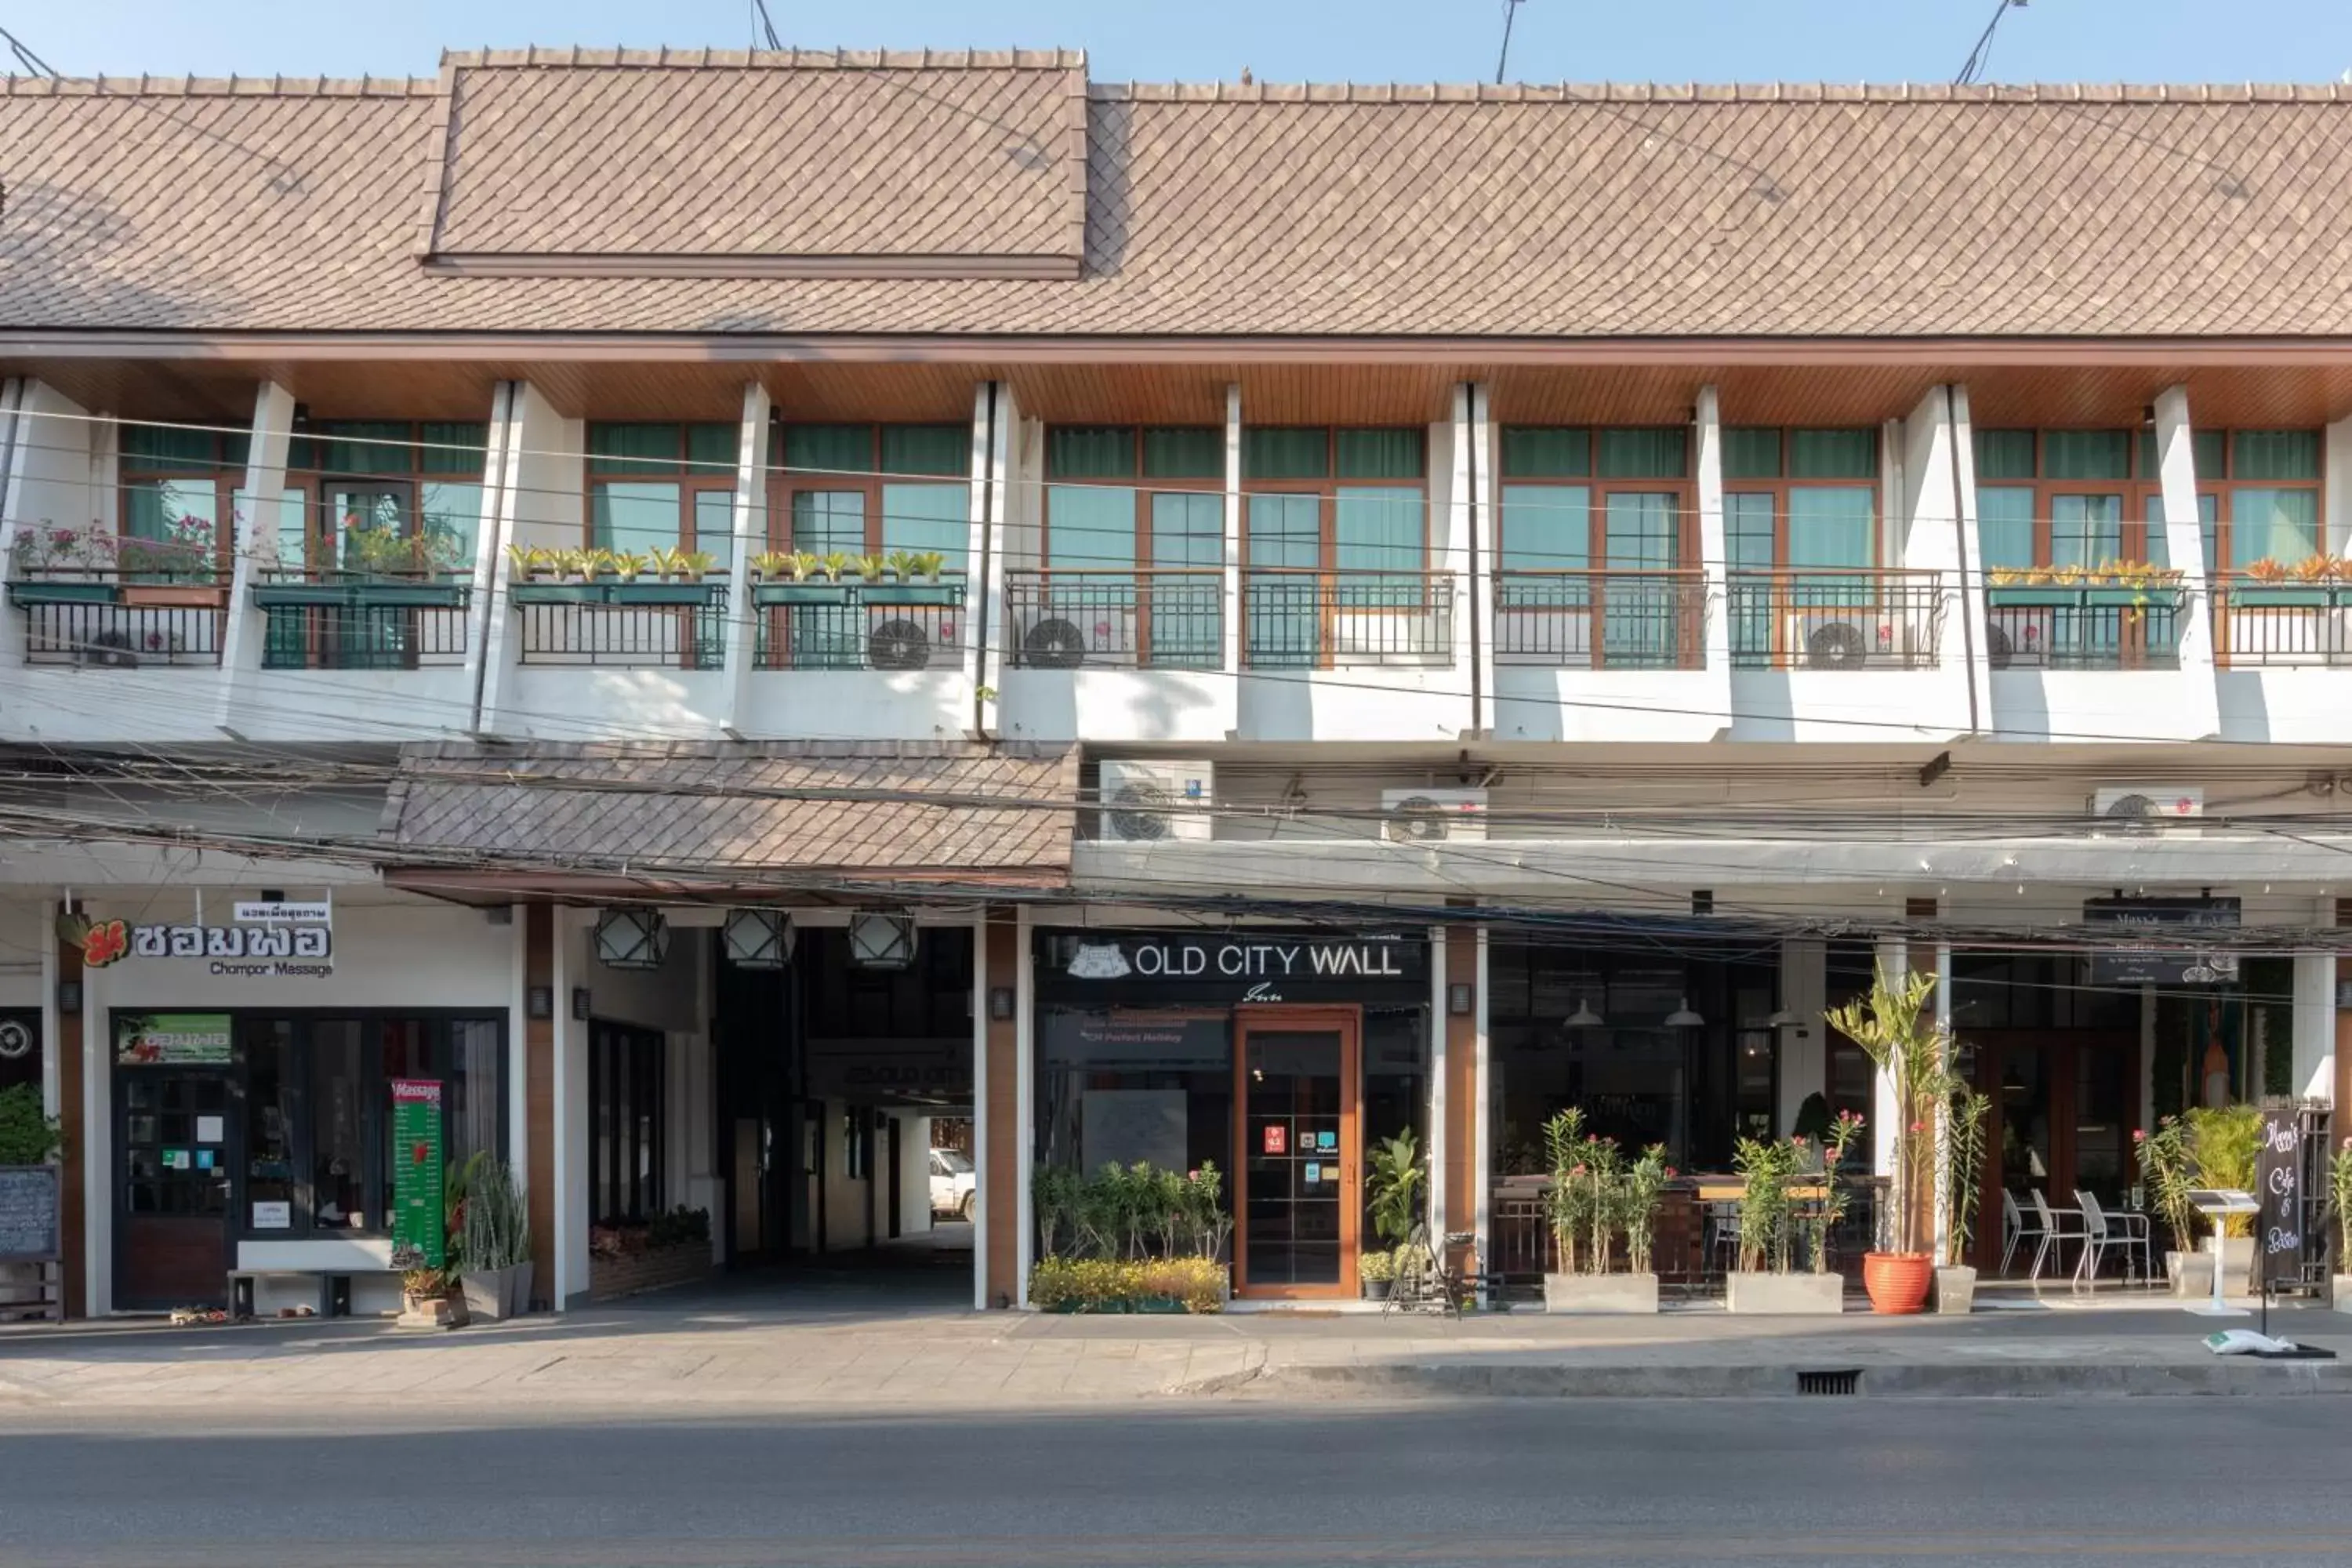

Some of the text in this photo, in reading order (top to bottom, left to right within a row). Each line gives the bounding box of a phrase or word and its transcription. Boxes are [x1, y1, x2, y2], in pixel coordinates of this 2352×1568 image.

[133, 924, 331, 957] ชอมพอ
[210, 962, 332, 978] Chompor Massage
[1136, 946, 1402, 975] OLD CITY WALL
[1105, 1032, 1141, 1043] Perfect
[1143, 1032, 1183, 1044] Holiday
